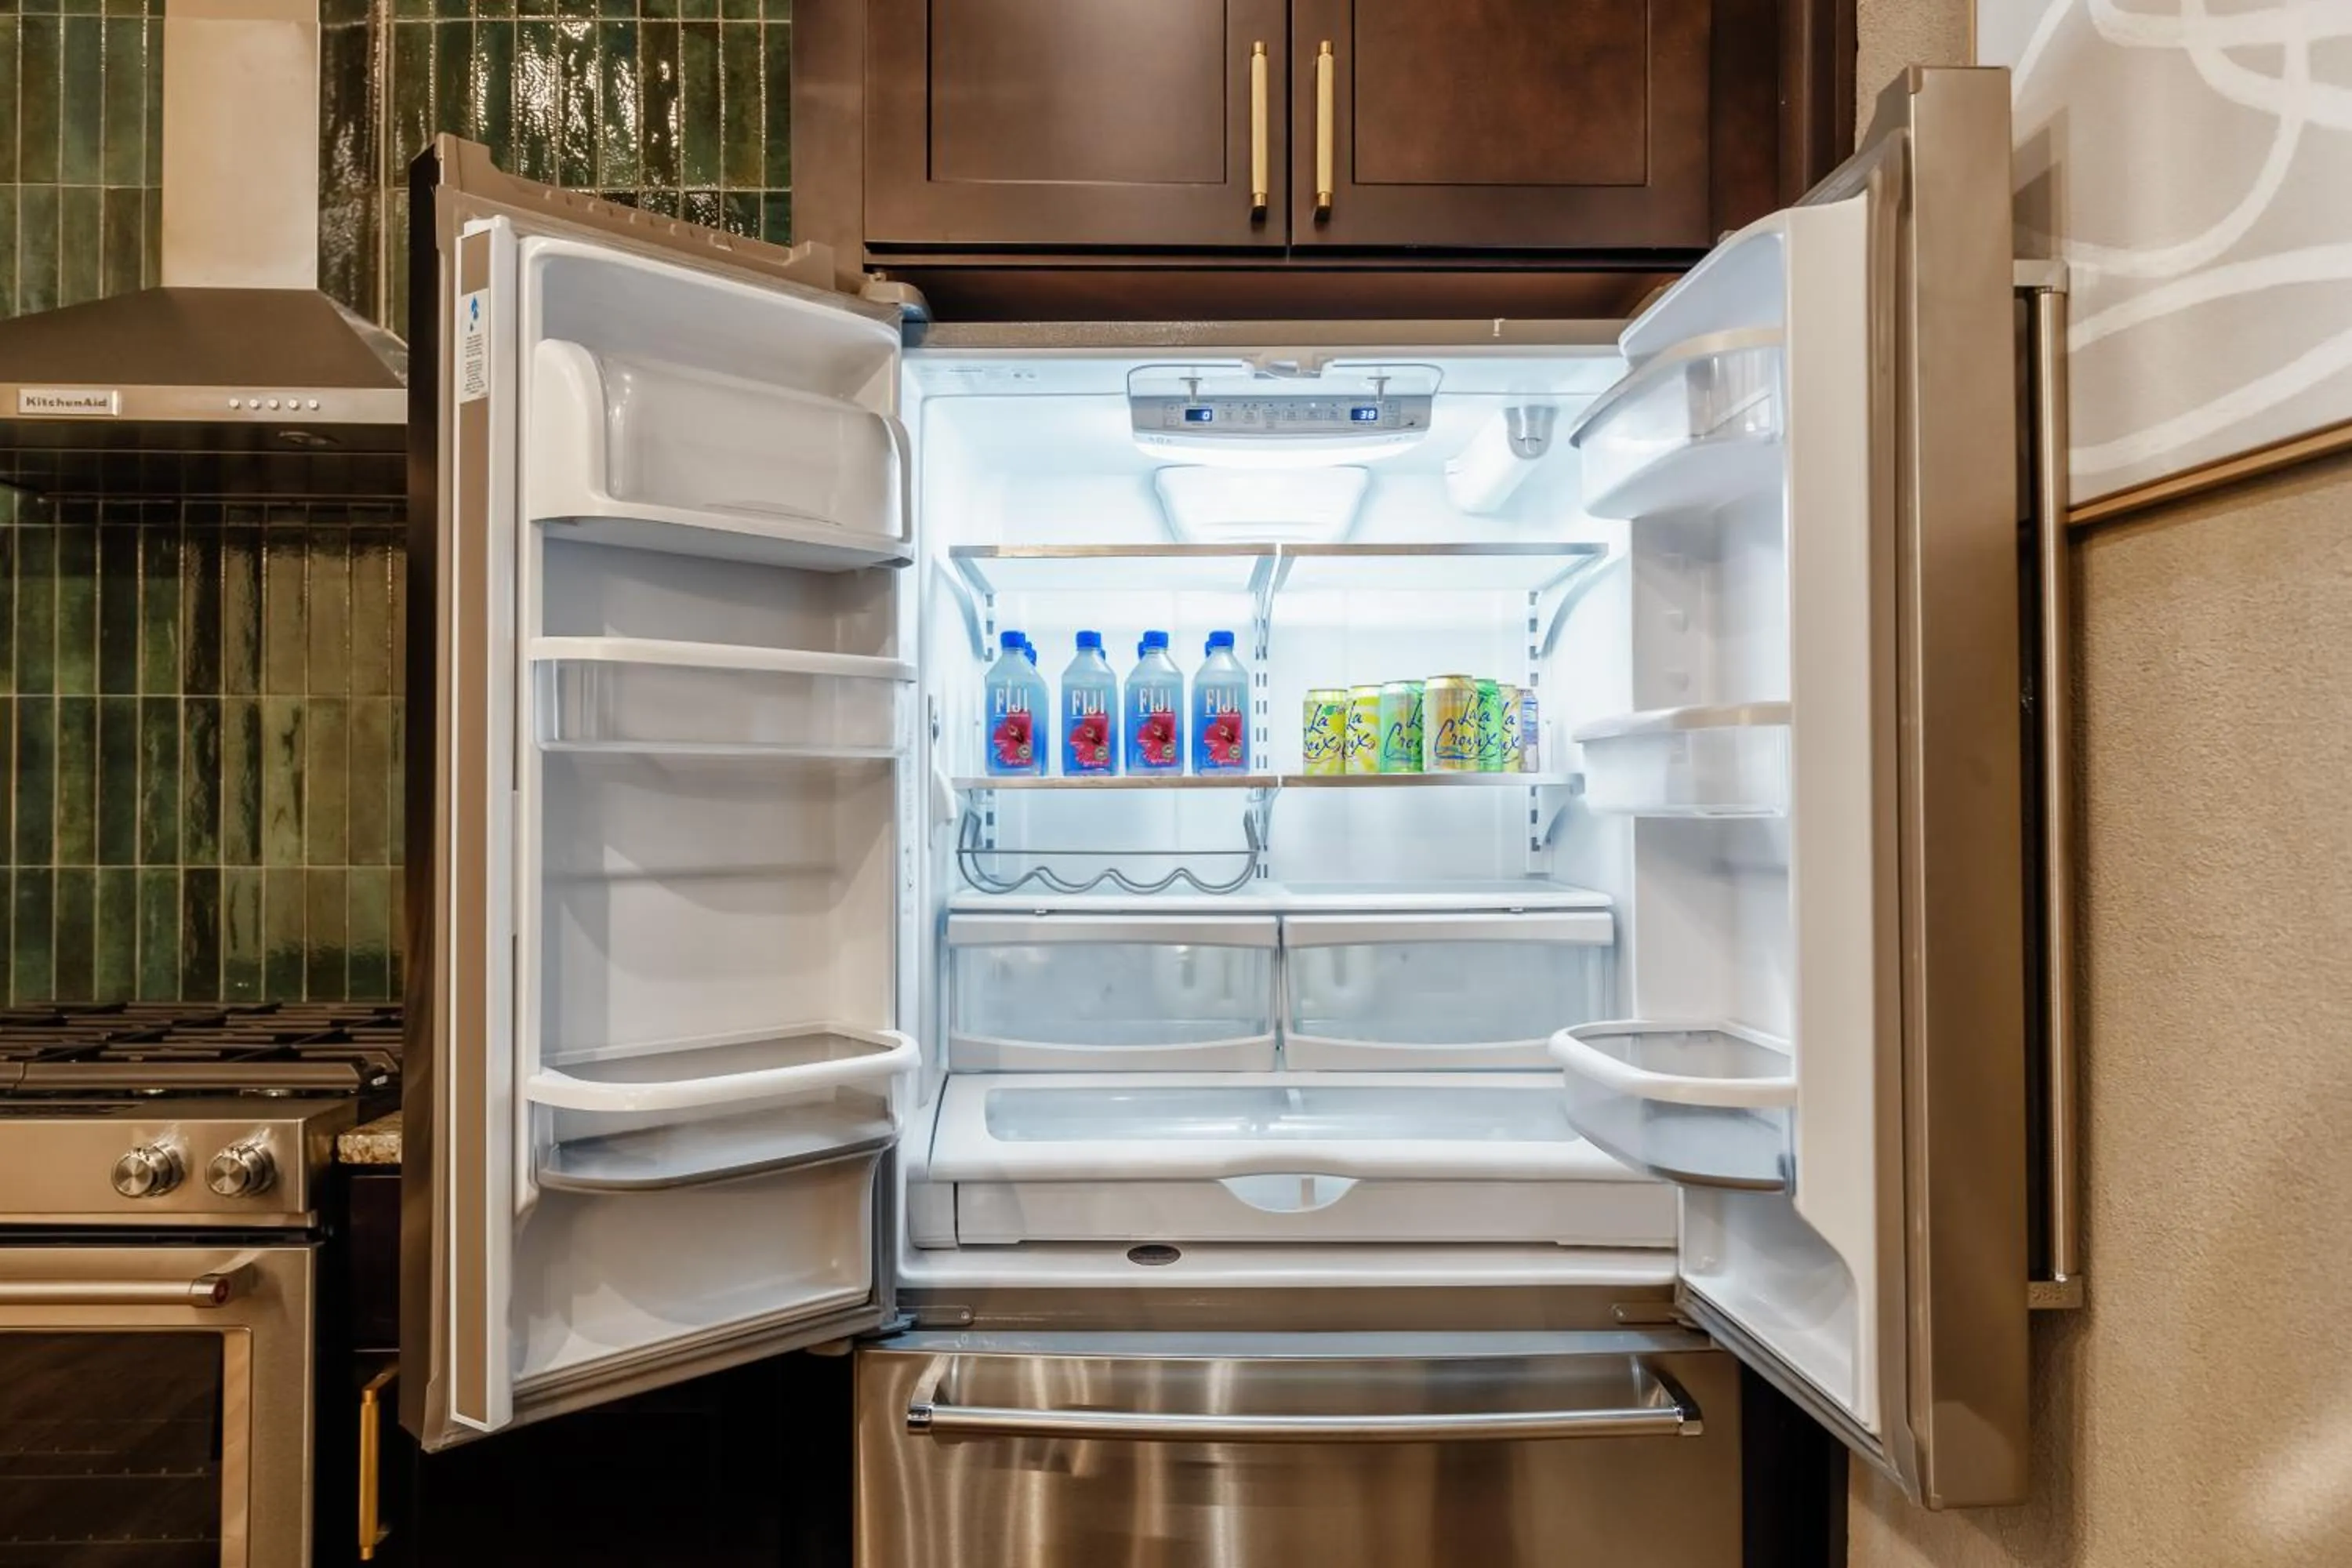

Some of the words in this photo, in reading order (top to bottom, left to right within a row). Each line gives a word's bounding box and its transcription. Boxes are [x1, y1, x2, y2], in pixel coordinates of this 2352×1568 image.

[26, 396, 107, 407] KitchenAid
[1360, 410, 1376, 419] 38
[996, 688, 1028, 713] FIJI
[1071, 689, 1105, 716] FIJI
[1138, 688, 1171, 713] FIJI
[1205, 688, 1240, 714] FIJI
